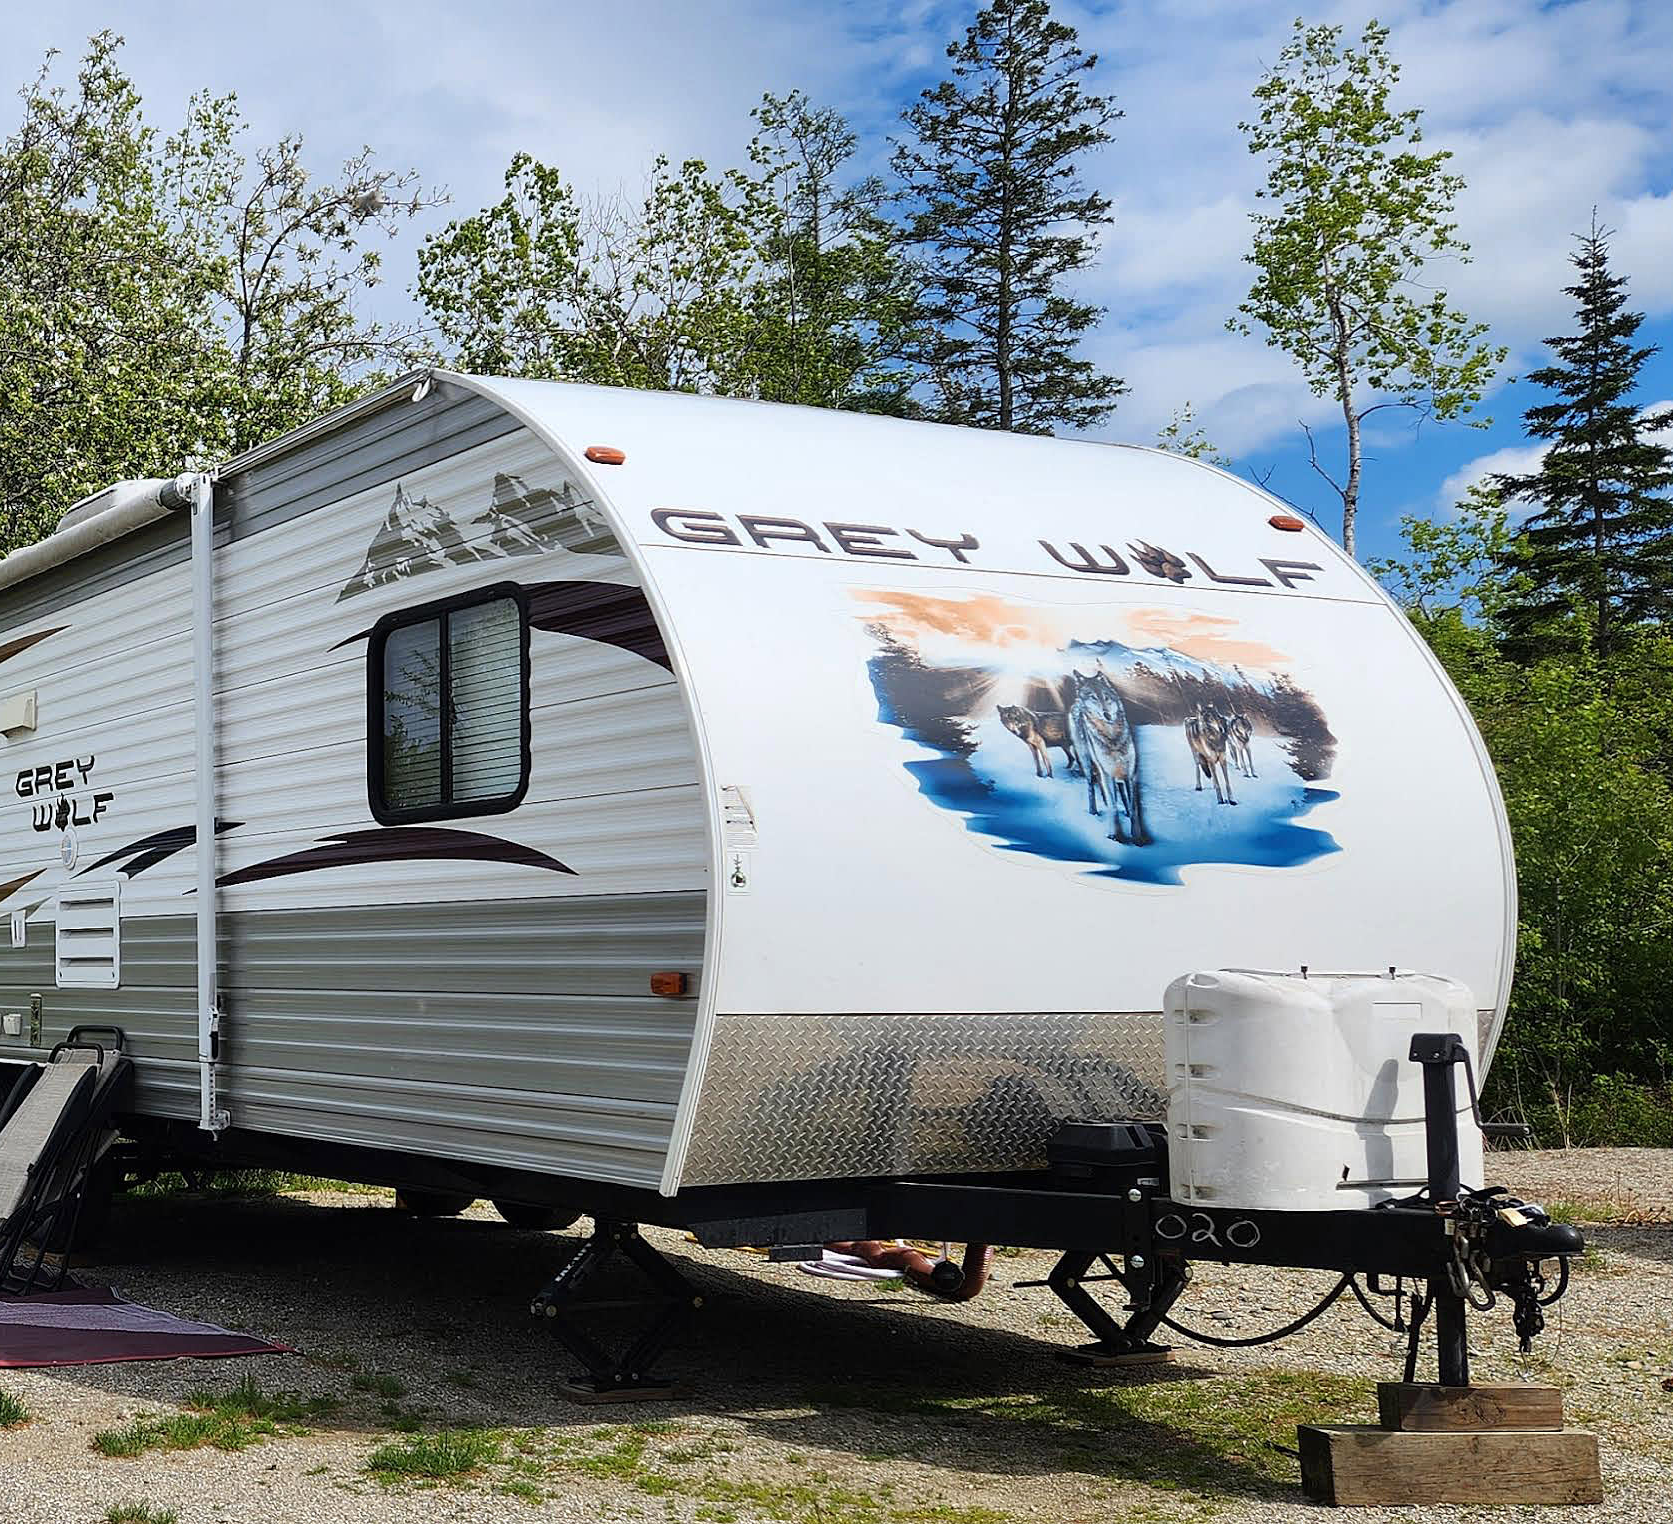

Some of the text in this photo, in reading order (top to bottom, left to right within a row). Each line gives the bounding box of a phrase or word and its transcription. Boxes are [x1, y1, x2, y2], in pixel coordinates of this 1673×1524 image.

[650, 507, 981, 565] GREY
[15, 754, 95, 798] GREY
[1154, 1212, 1261, 1248] 020
